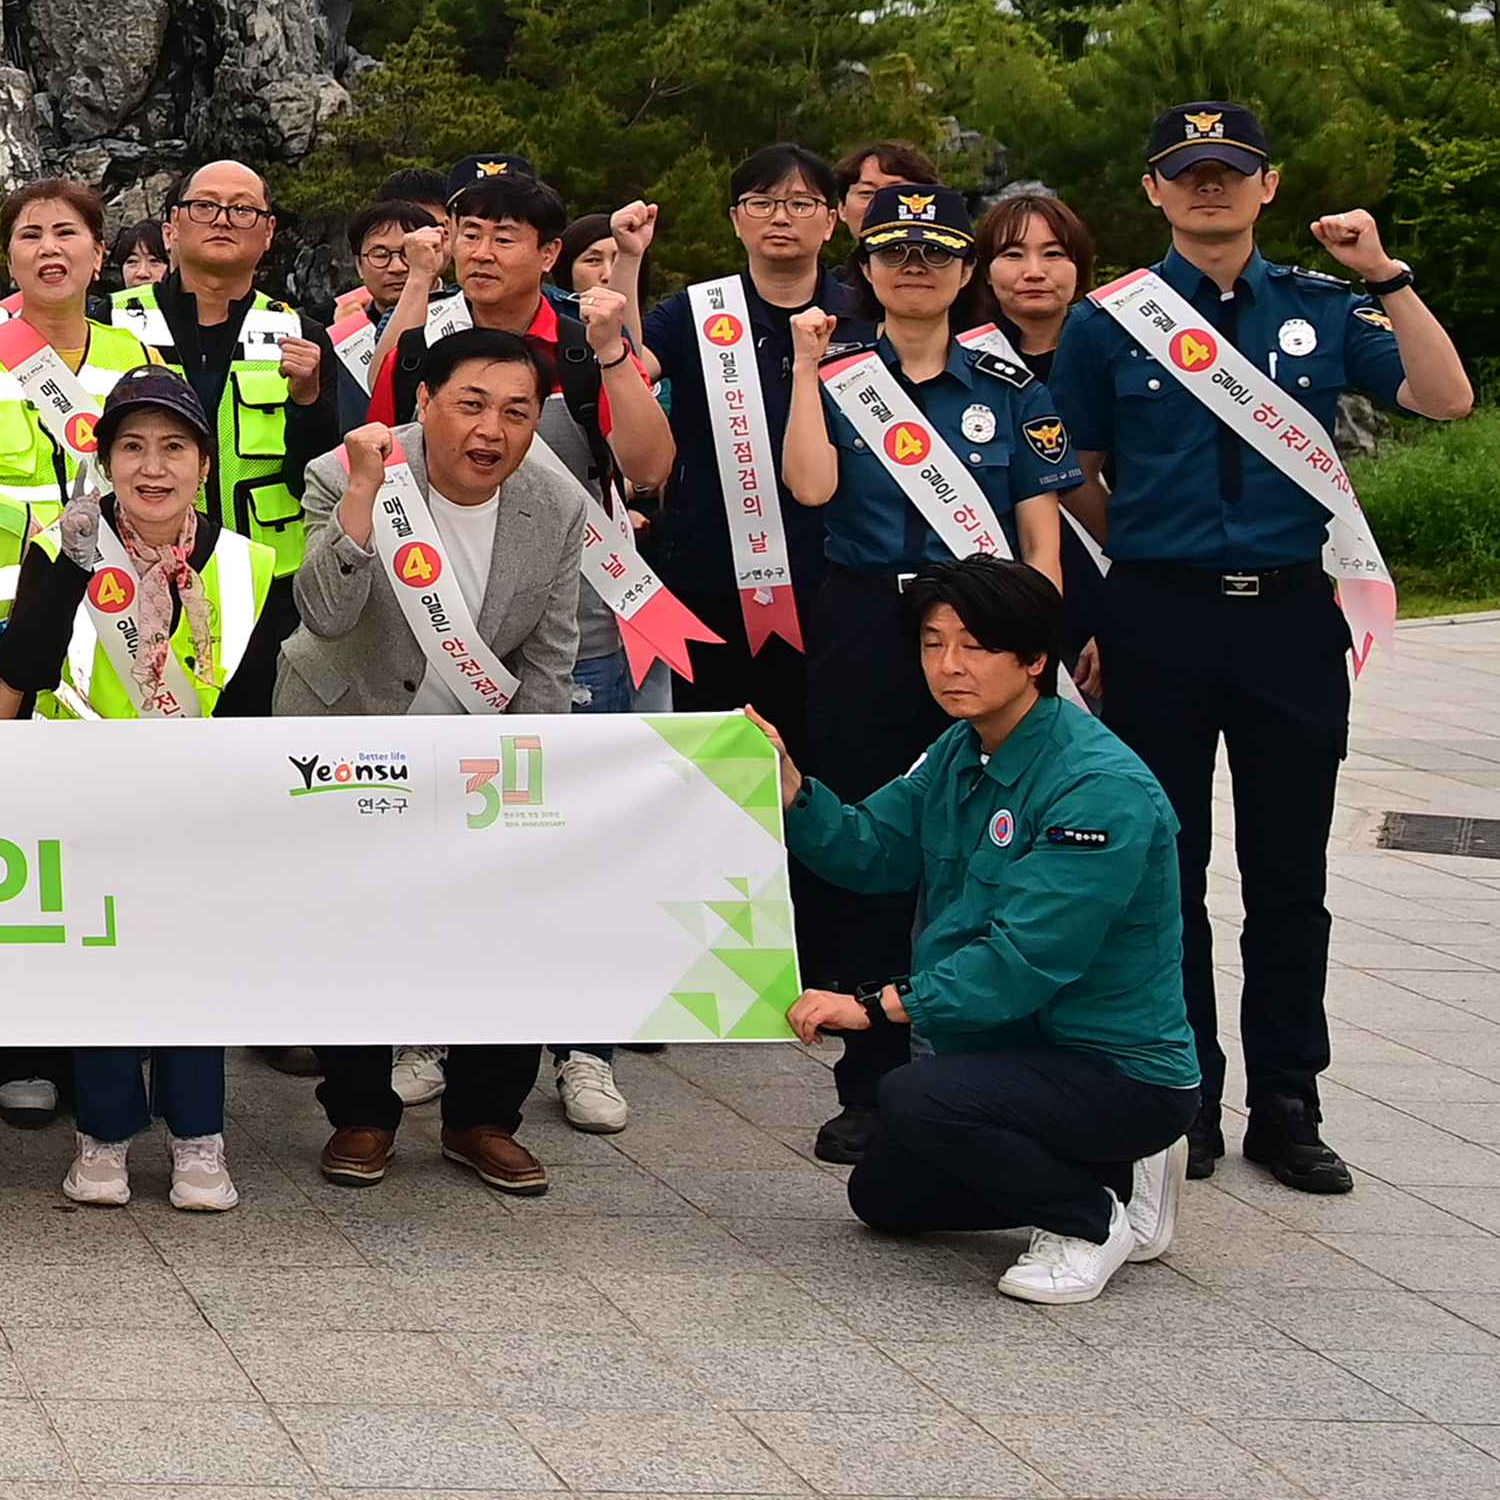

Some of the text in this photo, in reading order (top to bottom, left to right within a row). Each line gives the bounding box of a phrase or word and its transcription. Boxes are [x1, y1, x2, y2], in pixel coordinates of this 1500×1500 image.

[1139, 299, 1178, 333] 매월
[40, 378, 74, 414] 매월
[858, 385, 895, 423] 매월
[707, 286, 726, 311] 매월
[724, 388, 763, 518] 안전점검의
[748, 530, 768, 555] 날
[382, 496, 414, 538] 매월
[600, 552, 627, 579] 날
[752, 567, 785, 581] 연수구
[624, 573, 653, 602] 연수구
[288, 754, 408, 790] Yeonsu
[359, 752, 406, 762] Better life
[358, 797, 409, 814] 연수구
